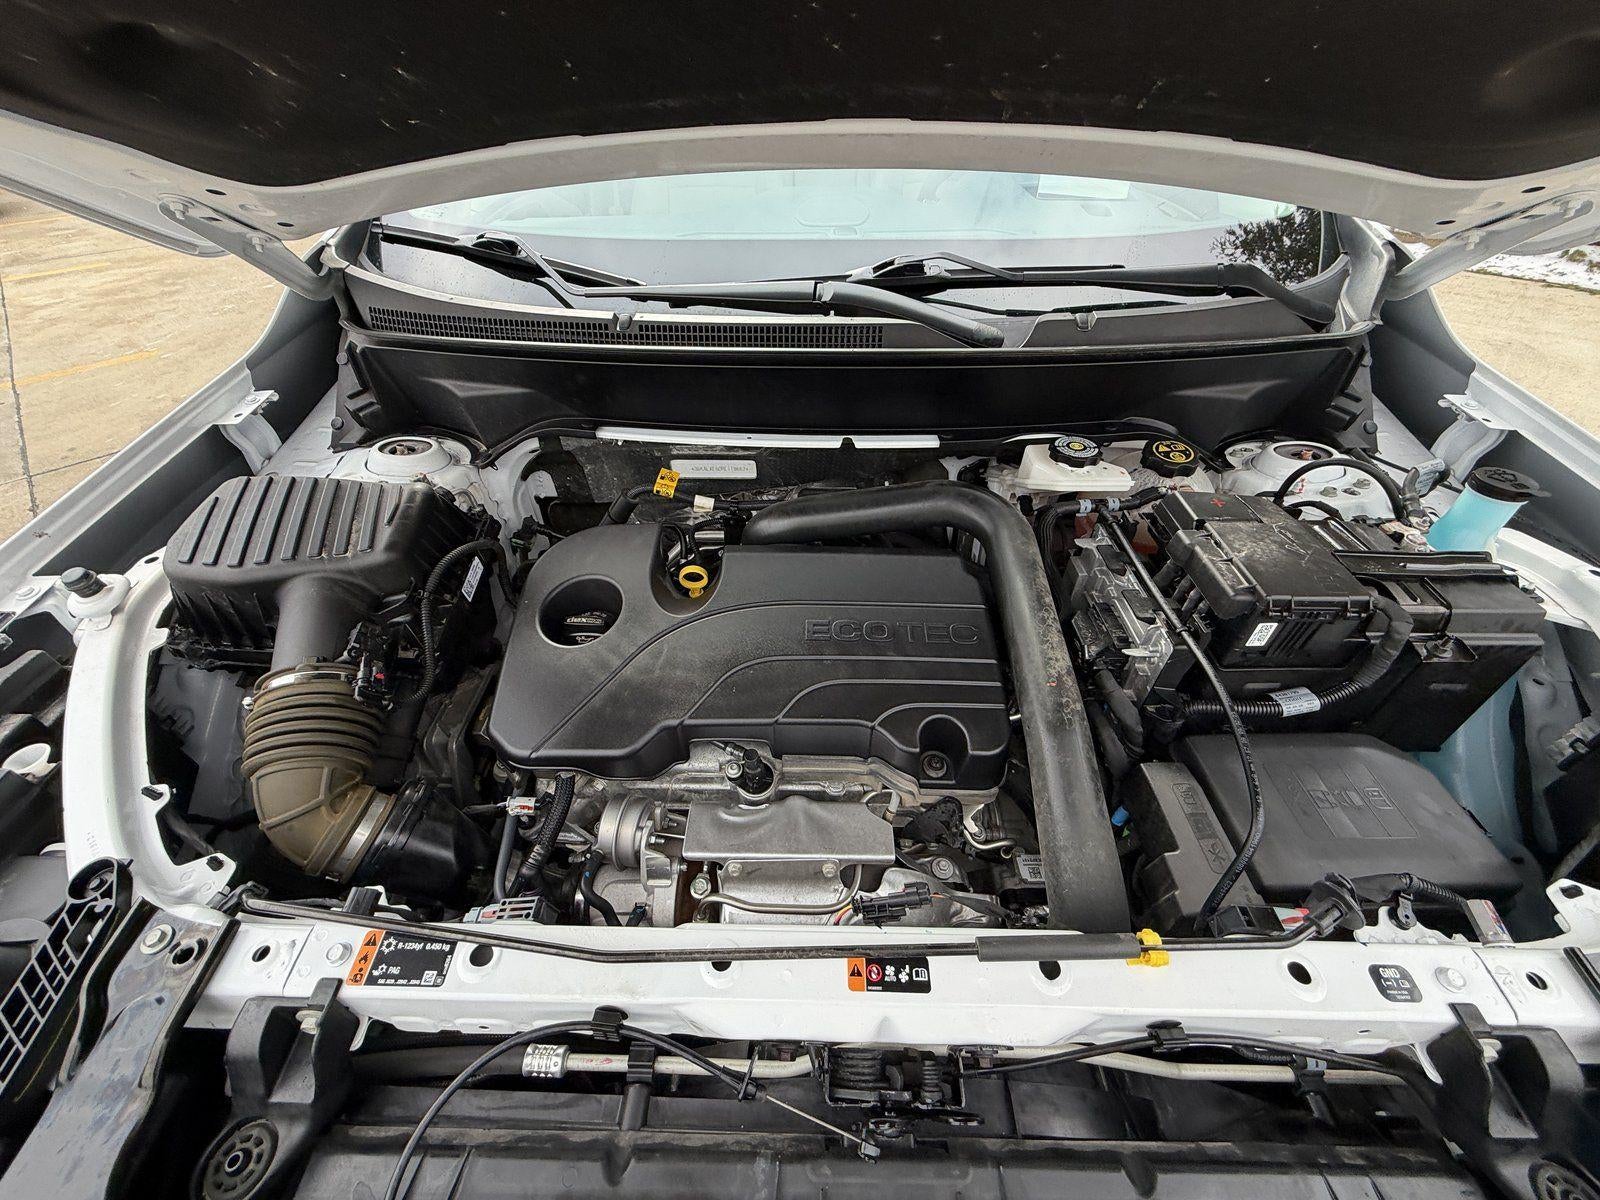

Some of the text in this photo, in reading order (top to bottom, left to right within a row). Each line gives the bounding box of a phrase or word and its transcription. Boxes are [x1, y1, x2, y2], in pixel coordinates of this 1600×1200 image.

[805, 619, 980, 645] ECOTEC
[397, 942, 424, 951] R-1234yf
[442, 943, 451, 952] kg
[387, 966, 401, 974] PAG
[1379, 967, 1401, 978] GND
